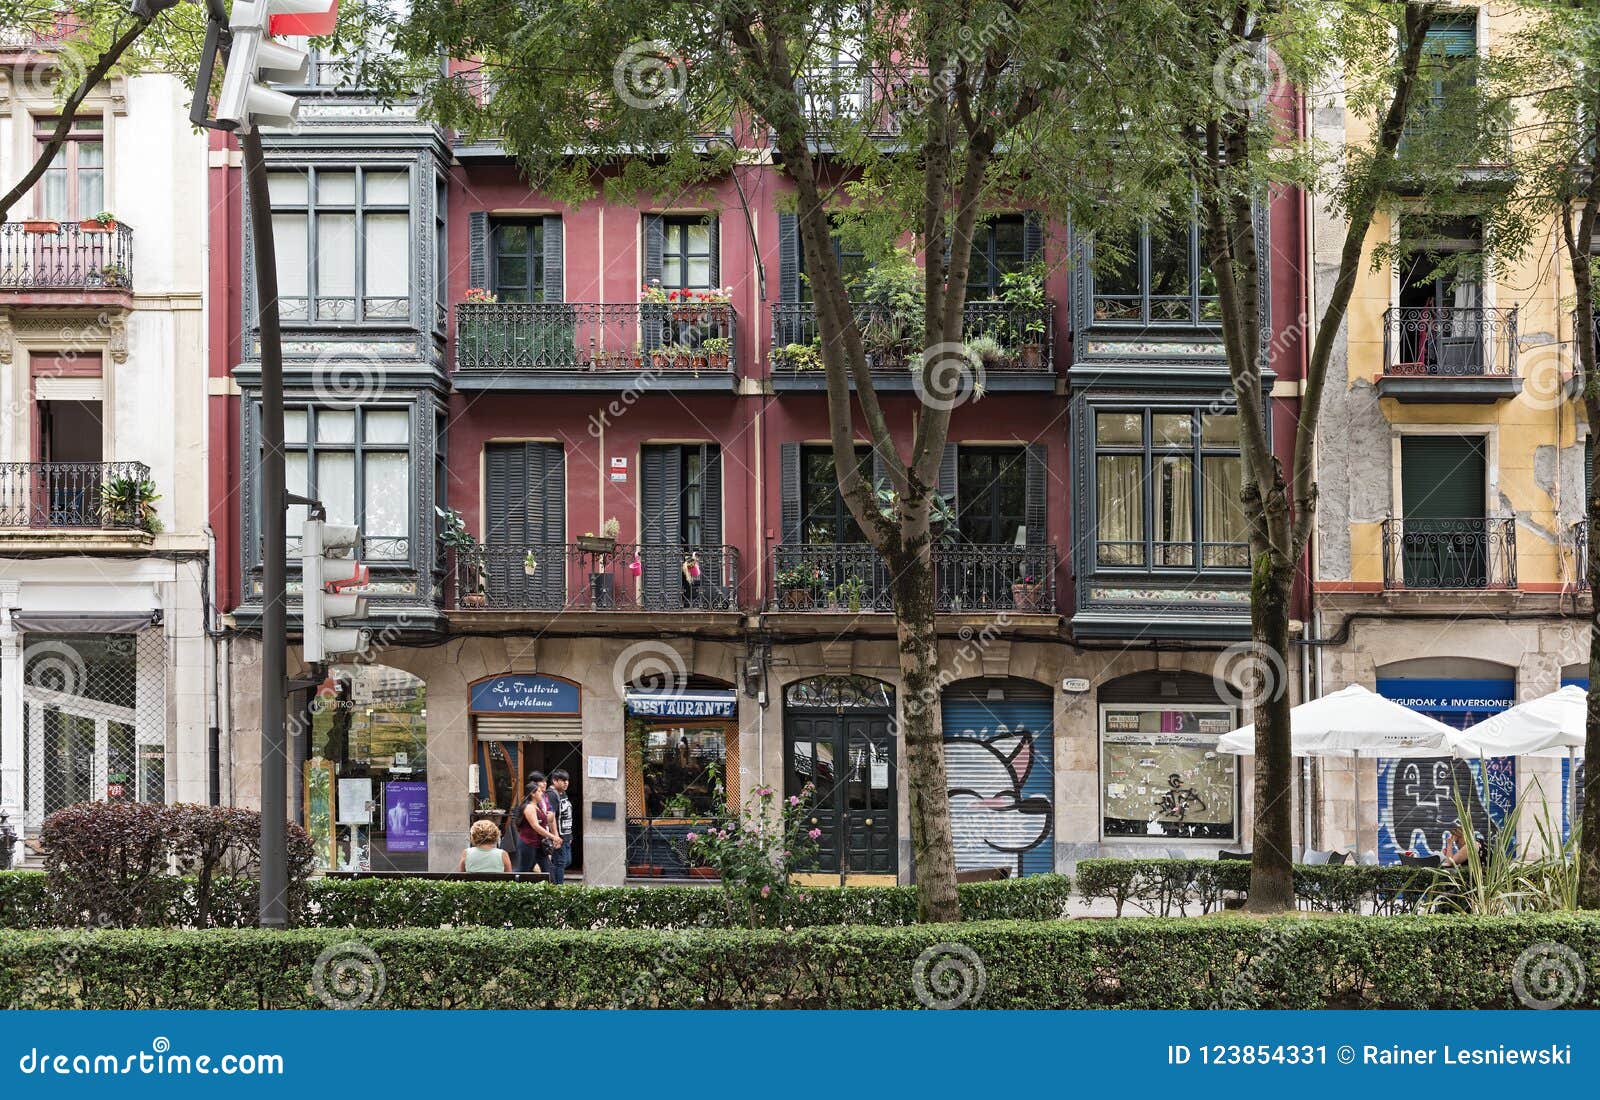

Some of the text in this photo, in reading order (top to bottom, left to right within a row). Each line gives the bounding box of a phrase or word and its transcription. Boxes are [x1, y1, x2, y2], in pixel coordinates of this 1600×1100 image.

[492, 681, 559, 694] La Trattoria
[498, 696, 553, 709] Napoletana
[632, 700, 732, 716] RESTAURANTE
[1390, 698, 1514, 707] EGUROAK & INVERSIONES
[1175, 715, 1184, 730] 3
